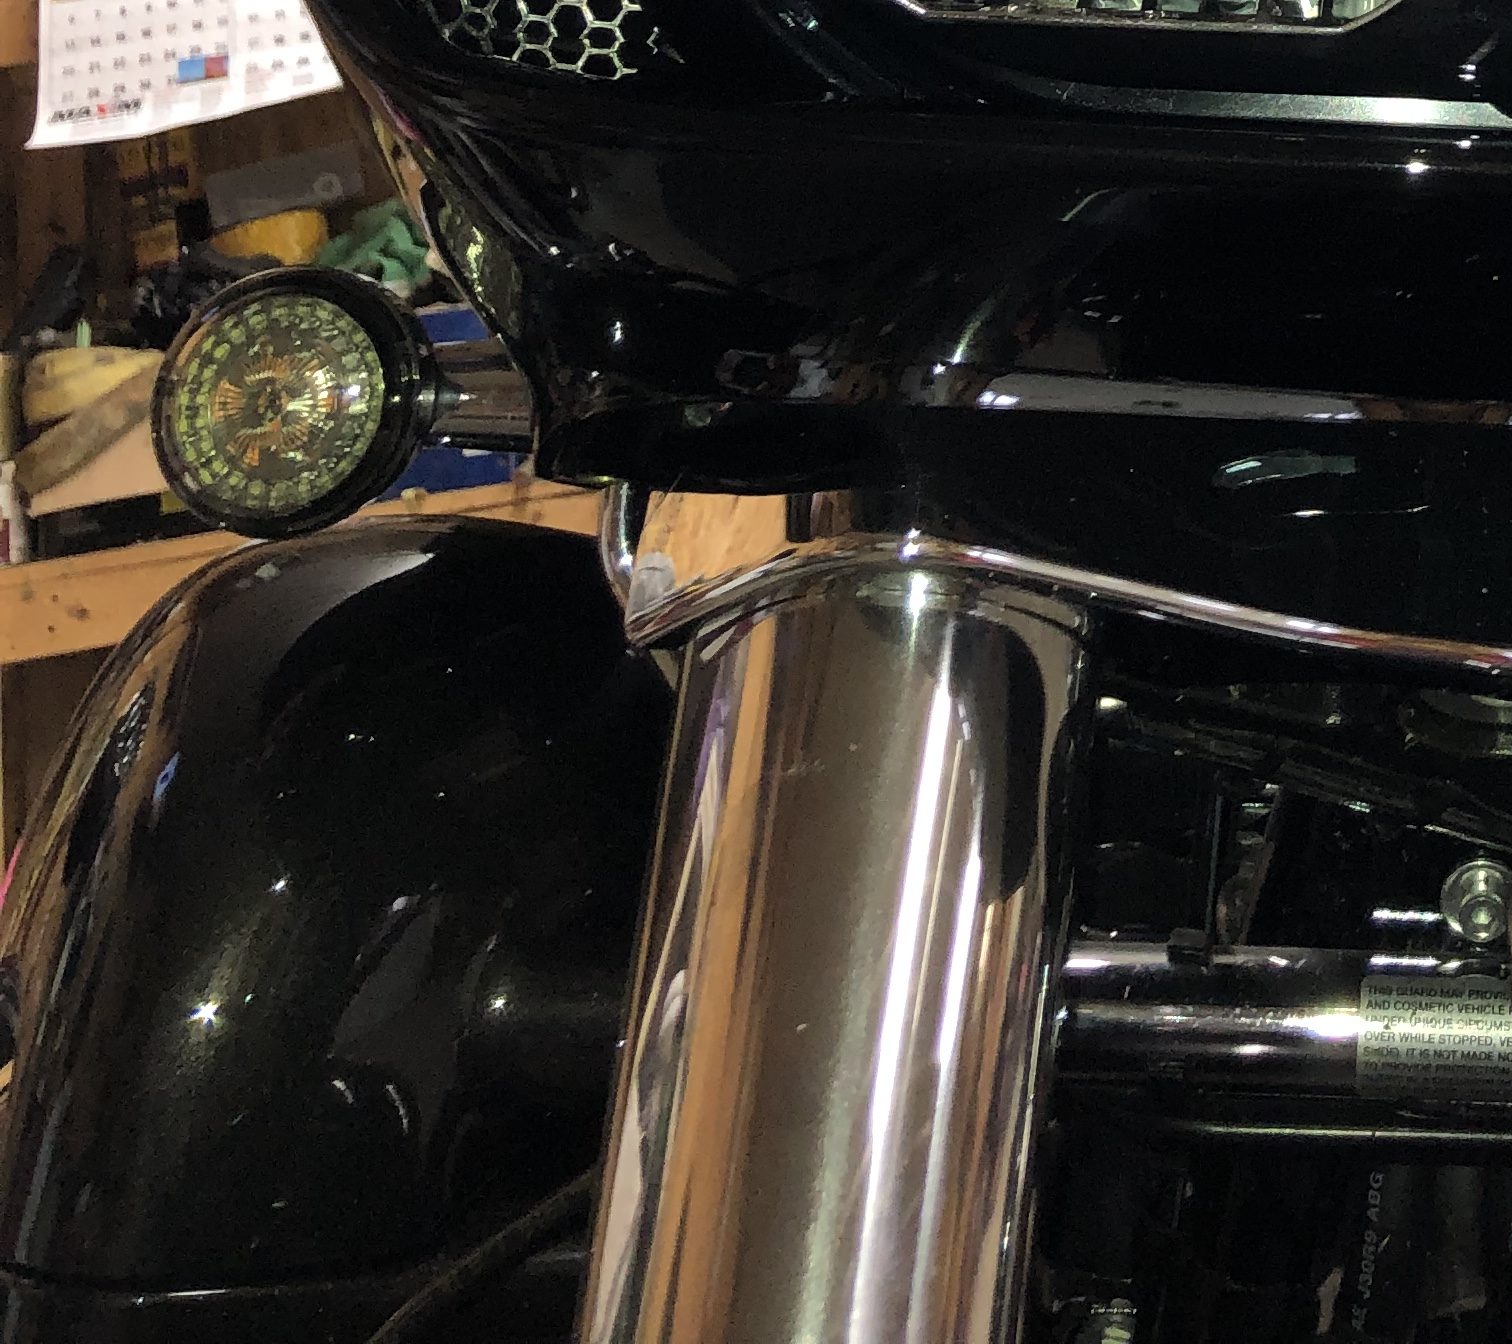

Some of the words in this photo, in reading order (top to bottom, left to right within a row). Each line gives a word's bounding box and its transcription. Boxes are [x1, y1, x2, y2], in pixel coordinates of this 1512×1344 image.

[1366, 999, 1391, 1011] AND
[1393, 1000, 1454, 1014] COSMETIC
[1457, 1003, 1505, 1016] VEHICLE
[1364, 1030, 1396, 1042] OVER
[1398, 1032, 1436, 1044] WHILE
[1406, 1047, 1417, 1058] IT
[1419, 1048, 1431, 1059] IS
[1433, 1049, 1459, 1061] NOT
[1461, 1050, 1496, 1062] MADE
